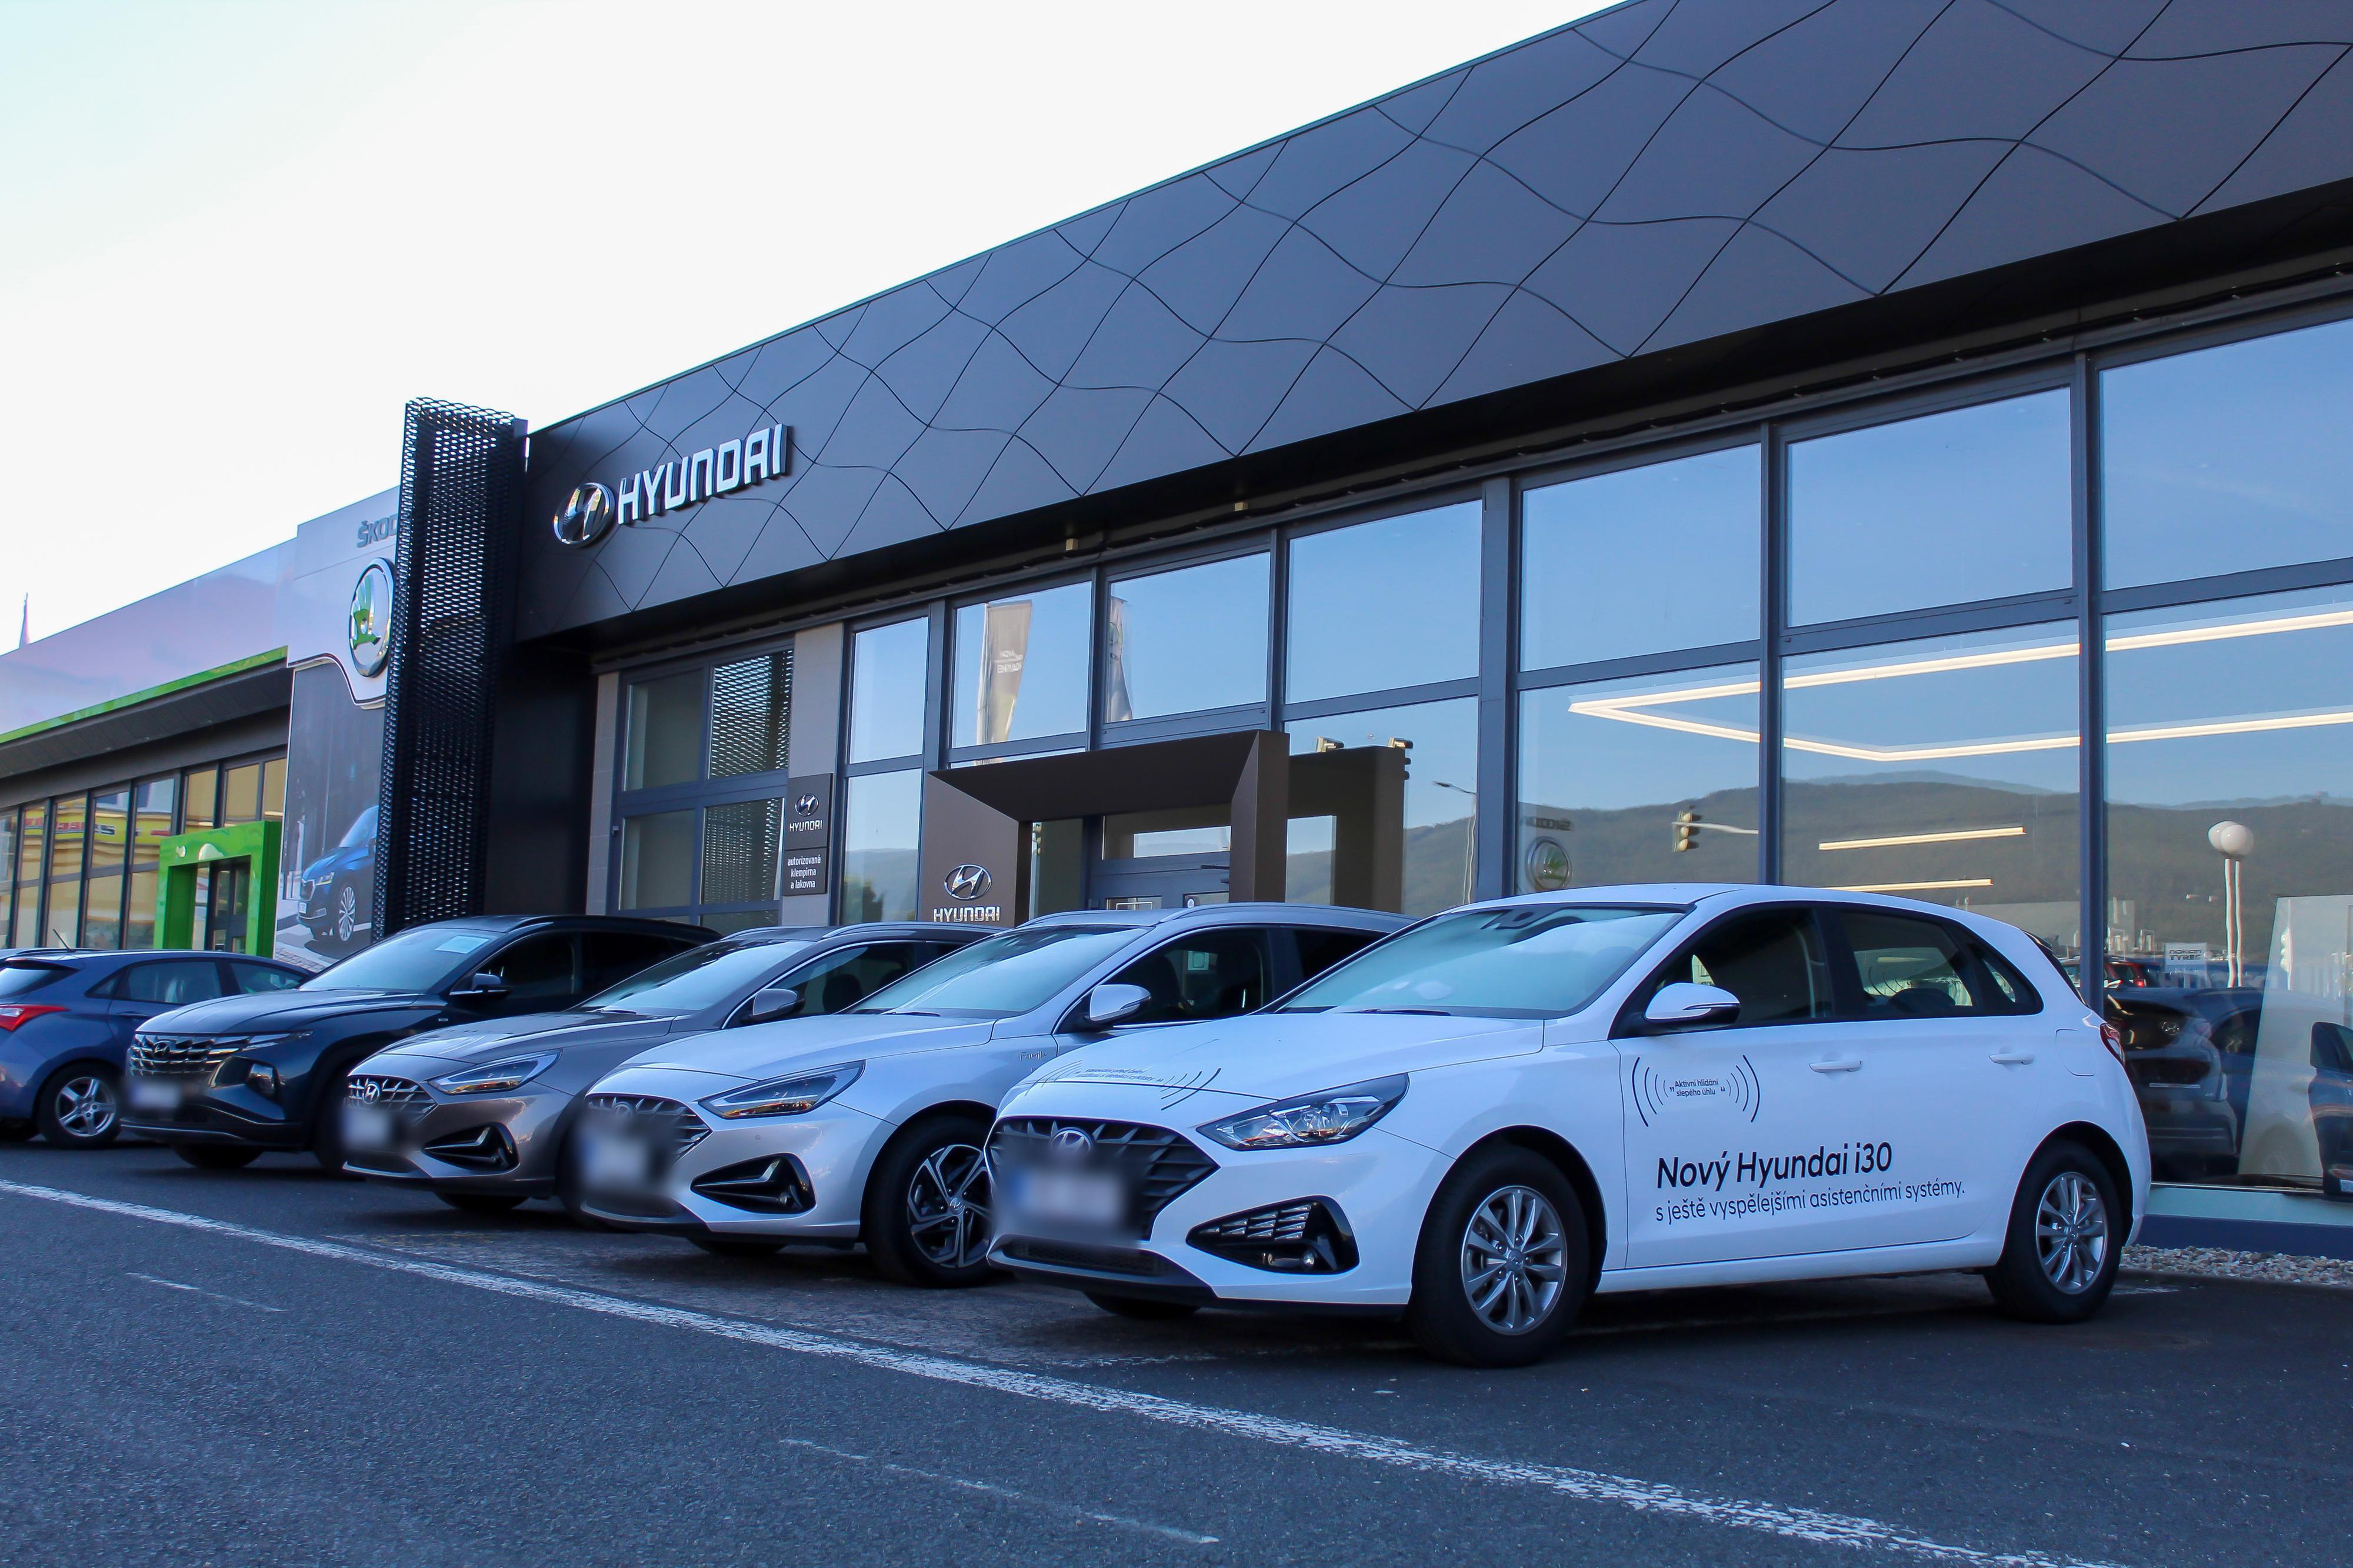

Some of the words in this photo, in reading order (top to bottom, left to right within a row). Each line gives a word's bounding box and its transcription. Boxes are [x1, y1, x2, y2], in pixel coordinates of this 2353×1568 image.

[618, 423, 786, 525] HYUNDAI
[357, 513, 398, 548] ŠKOD
[789, 820, 823, 832] HYUNDAI
[787, 855, 821, 866] autorizovaná
[791, 867, 816, 879] klempírna
[795, 880, 815, 889] lakovna
[933, 906, 1001, 922] HYUNDAI
[1675, 1079, 1696, 1087] Aktivní
[1697, 1078, 1719, 1086] hlídání
[1676, 1089, 1701, 1098] slepého
[1657, 1150, 1731, 1192] Nový
[1737, 1143, 1848, 1188] Hyundai
[1855, 1141, 1892, 1173] i30
[1656, 1206, 1664, 1222] s
[1668, 1197, 1705, 1225] ještě
[1709, 1189, 1806, 1220] vyspělejšími
[1809, 1181, 1902, 1208] asistenčními
[1905, 1177, 1965, 1202] systémy.
